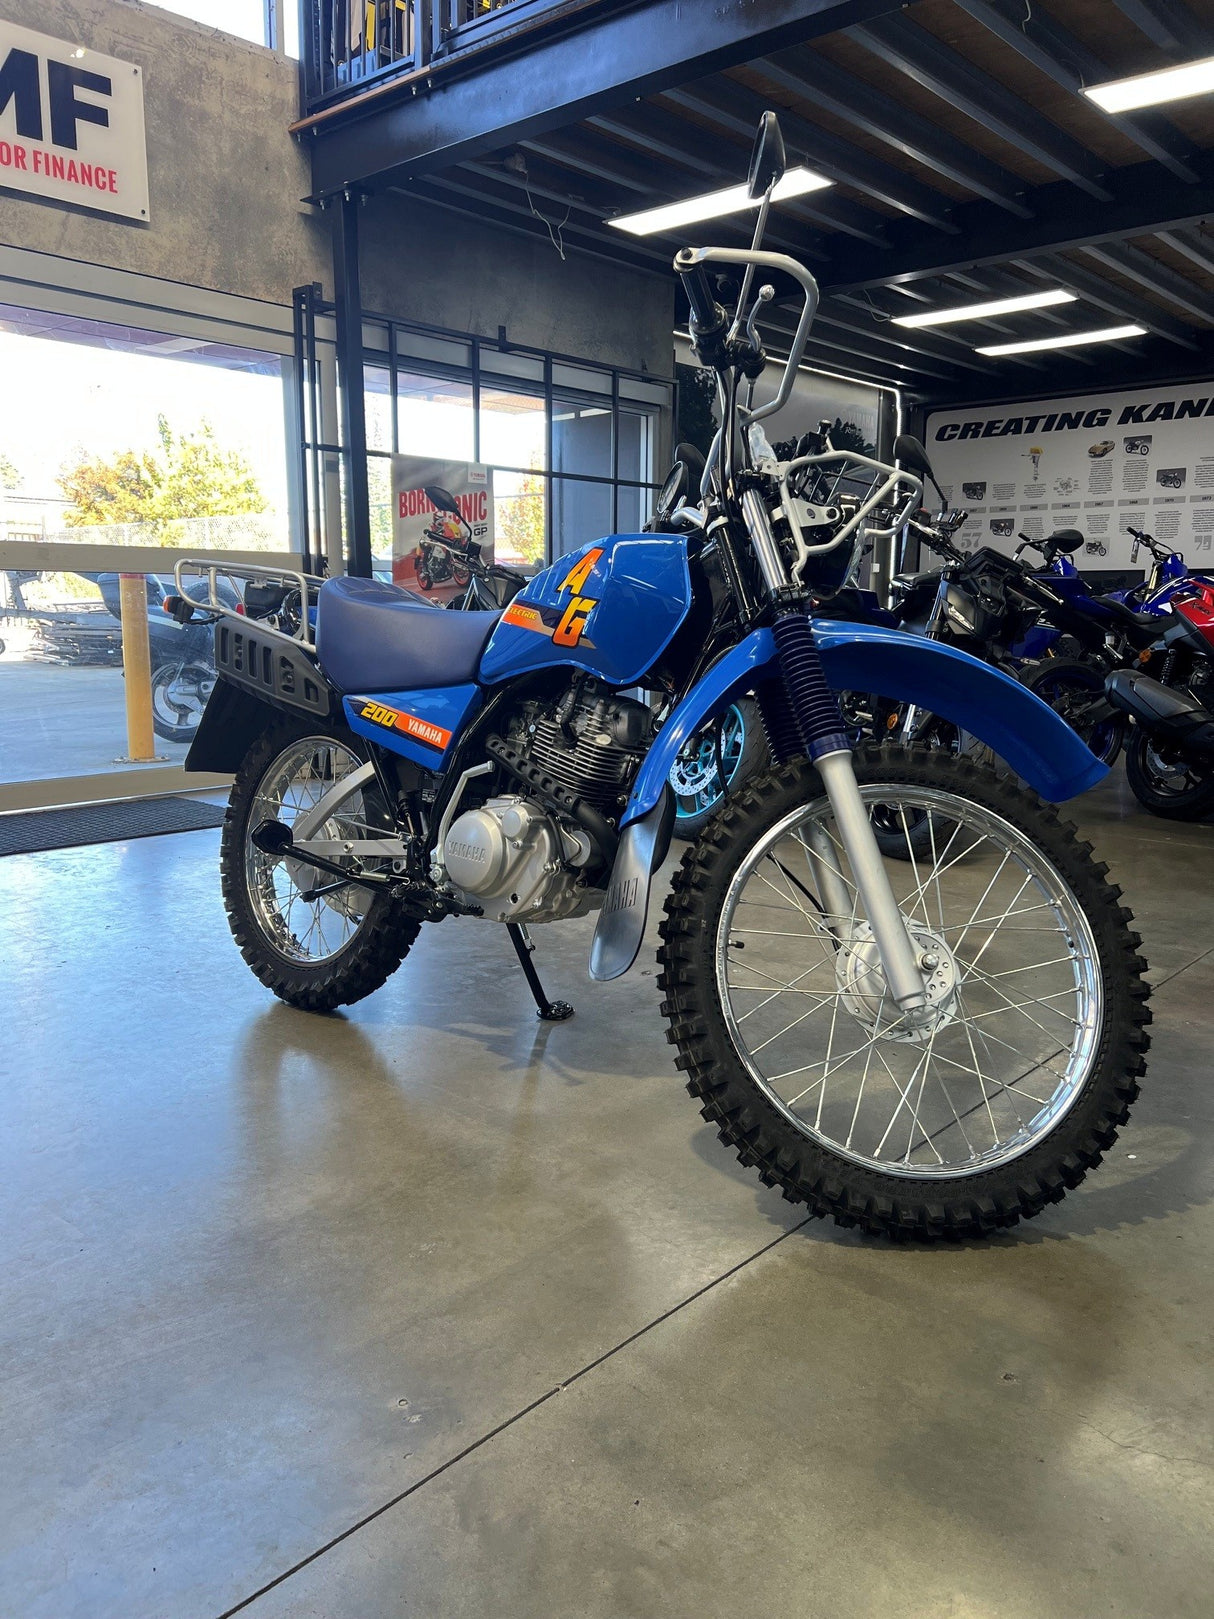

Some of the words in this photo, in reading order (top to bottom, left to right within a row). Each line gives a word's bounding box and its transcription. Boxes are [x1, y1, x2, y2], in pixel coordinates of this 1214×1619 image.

[33, 150, 118, 193] FINANCE
[935, 408, 1113, 442] CREATING
[473, 527, 488, 537] GP
[961, 532, 982, 549] 57
[360, 702, 400, 728] 200
[407, 719, 443, 745] YAMAHA
[448, 840, 487, 864] YAMAHA
